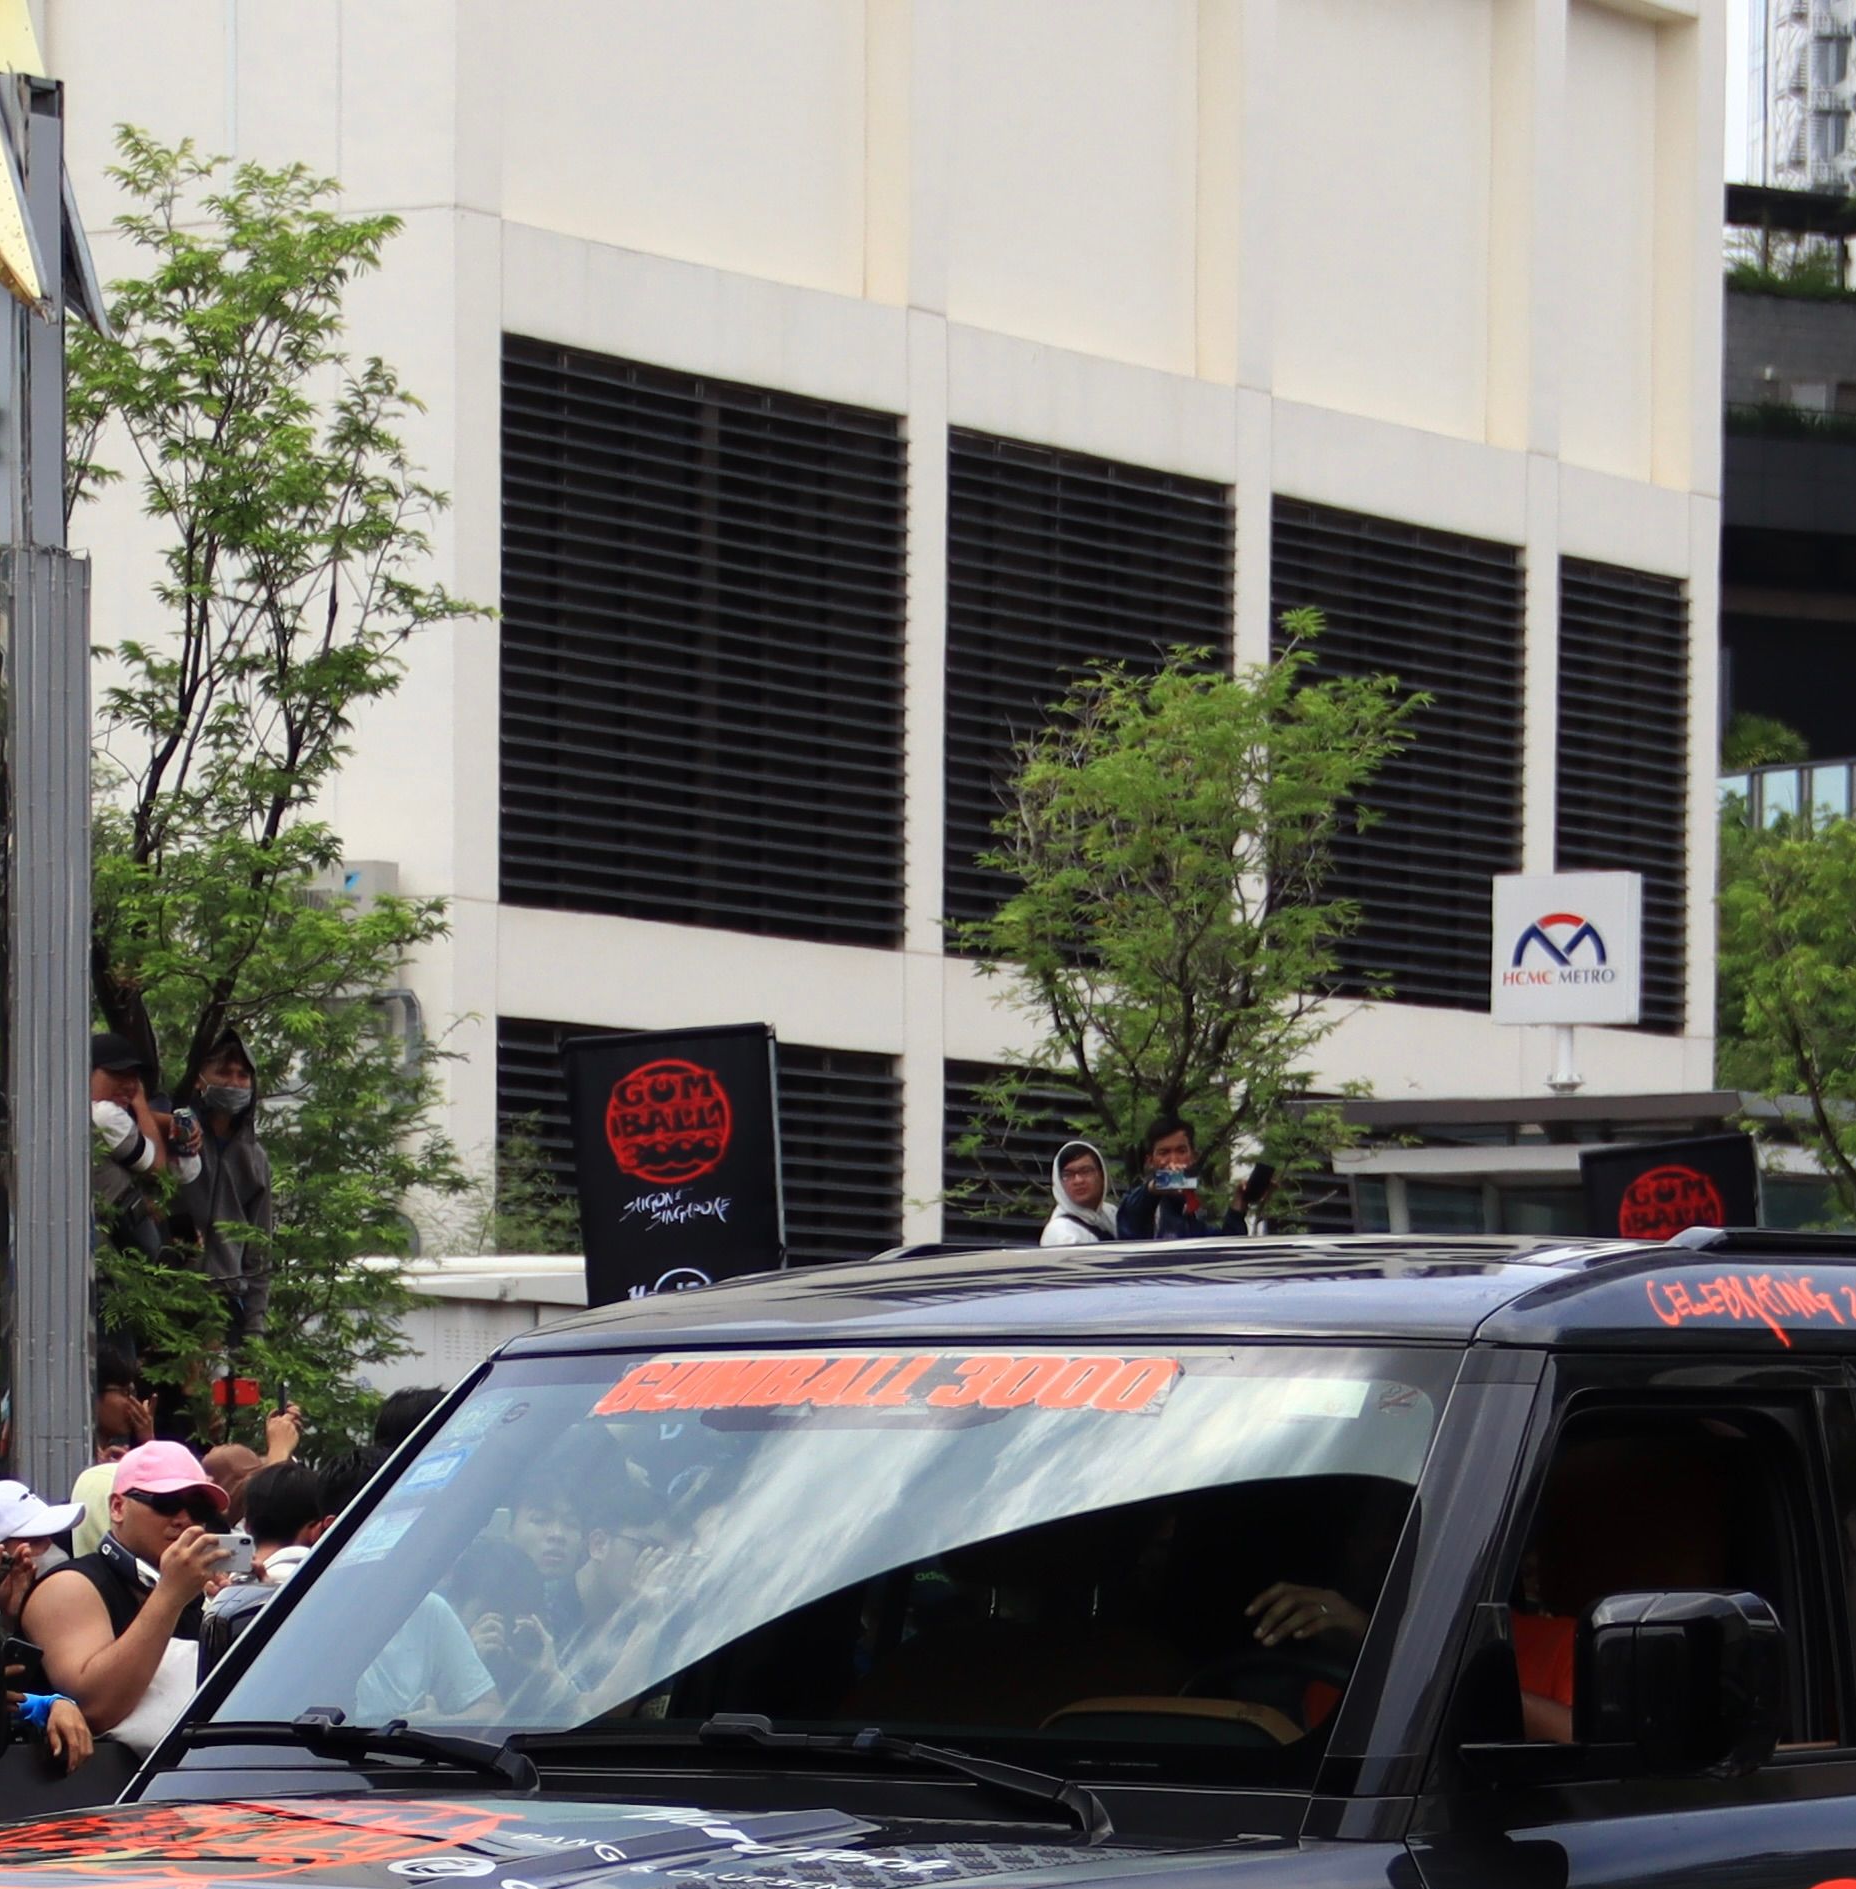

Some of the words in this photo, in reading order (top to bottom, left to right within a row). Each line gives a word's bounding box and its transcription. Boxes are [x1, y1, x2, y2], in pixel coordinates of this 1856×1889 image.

[1503, 971, 1552, 986] HCMC
[1558, 968, 1616, 985] METRO
[593, 1355, 939, 1416] GUMBALL
[926, 1355, 1180, 1412] 3000
